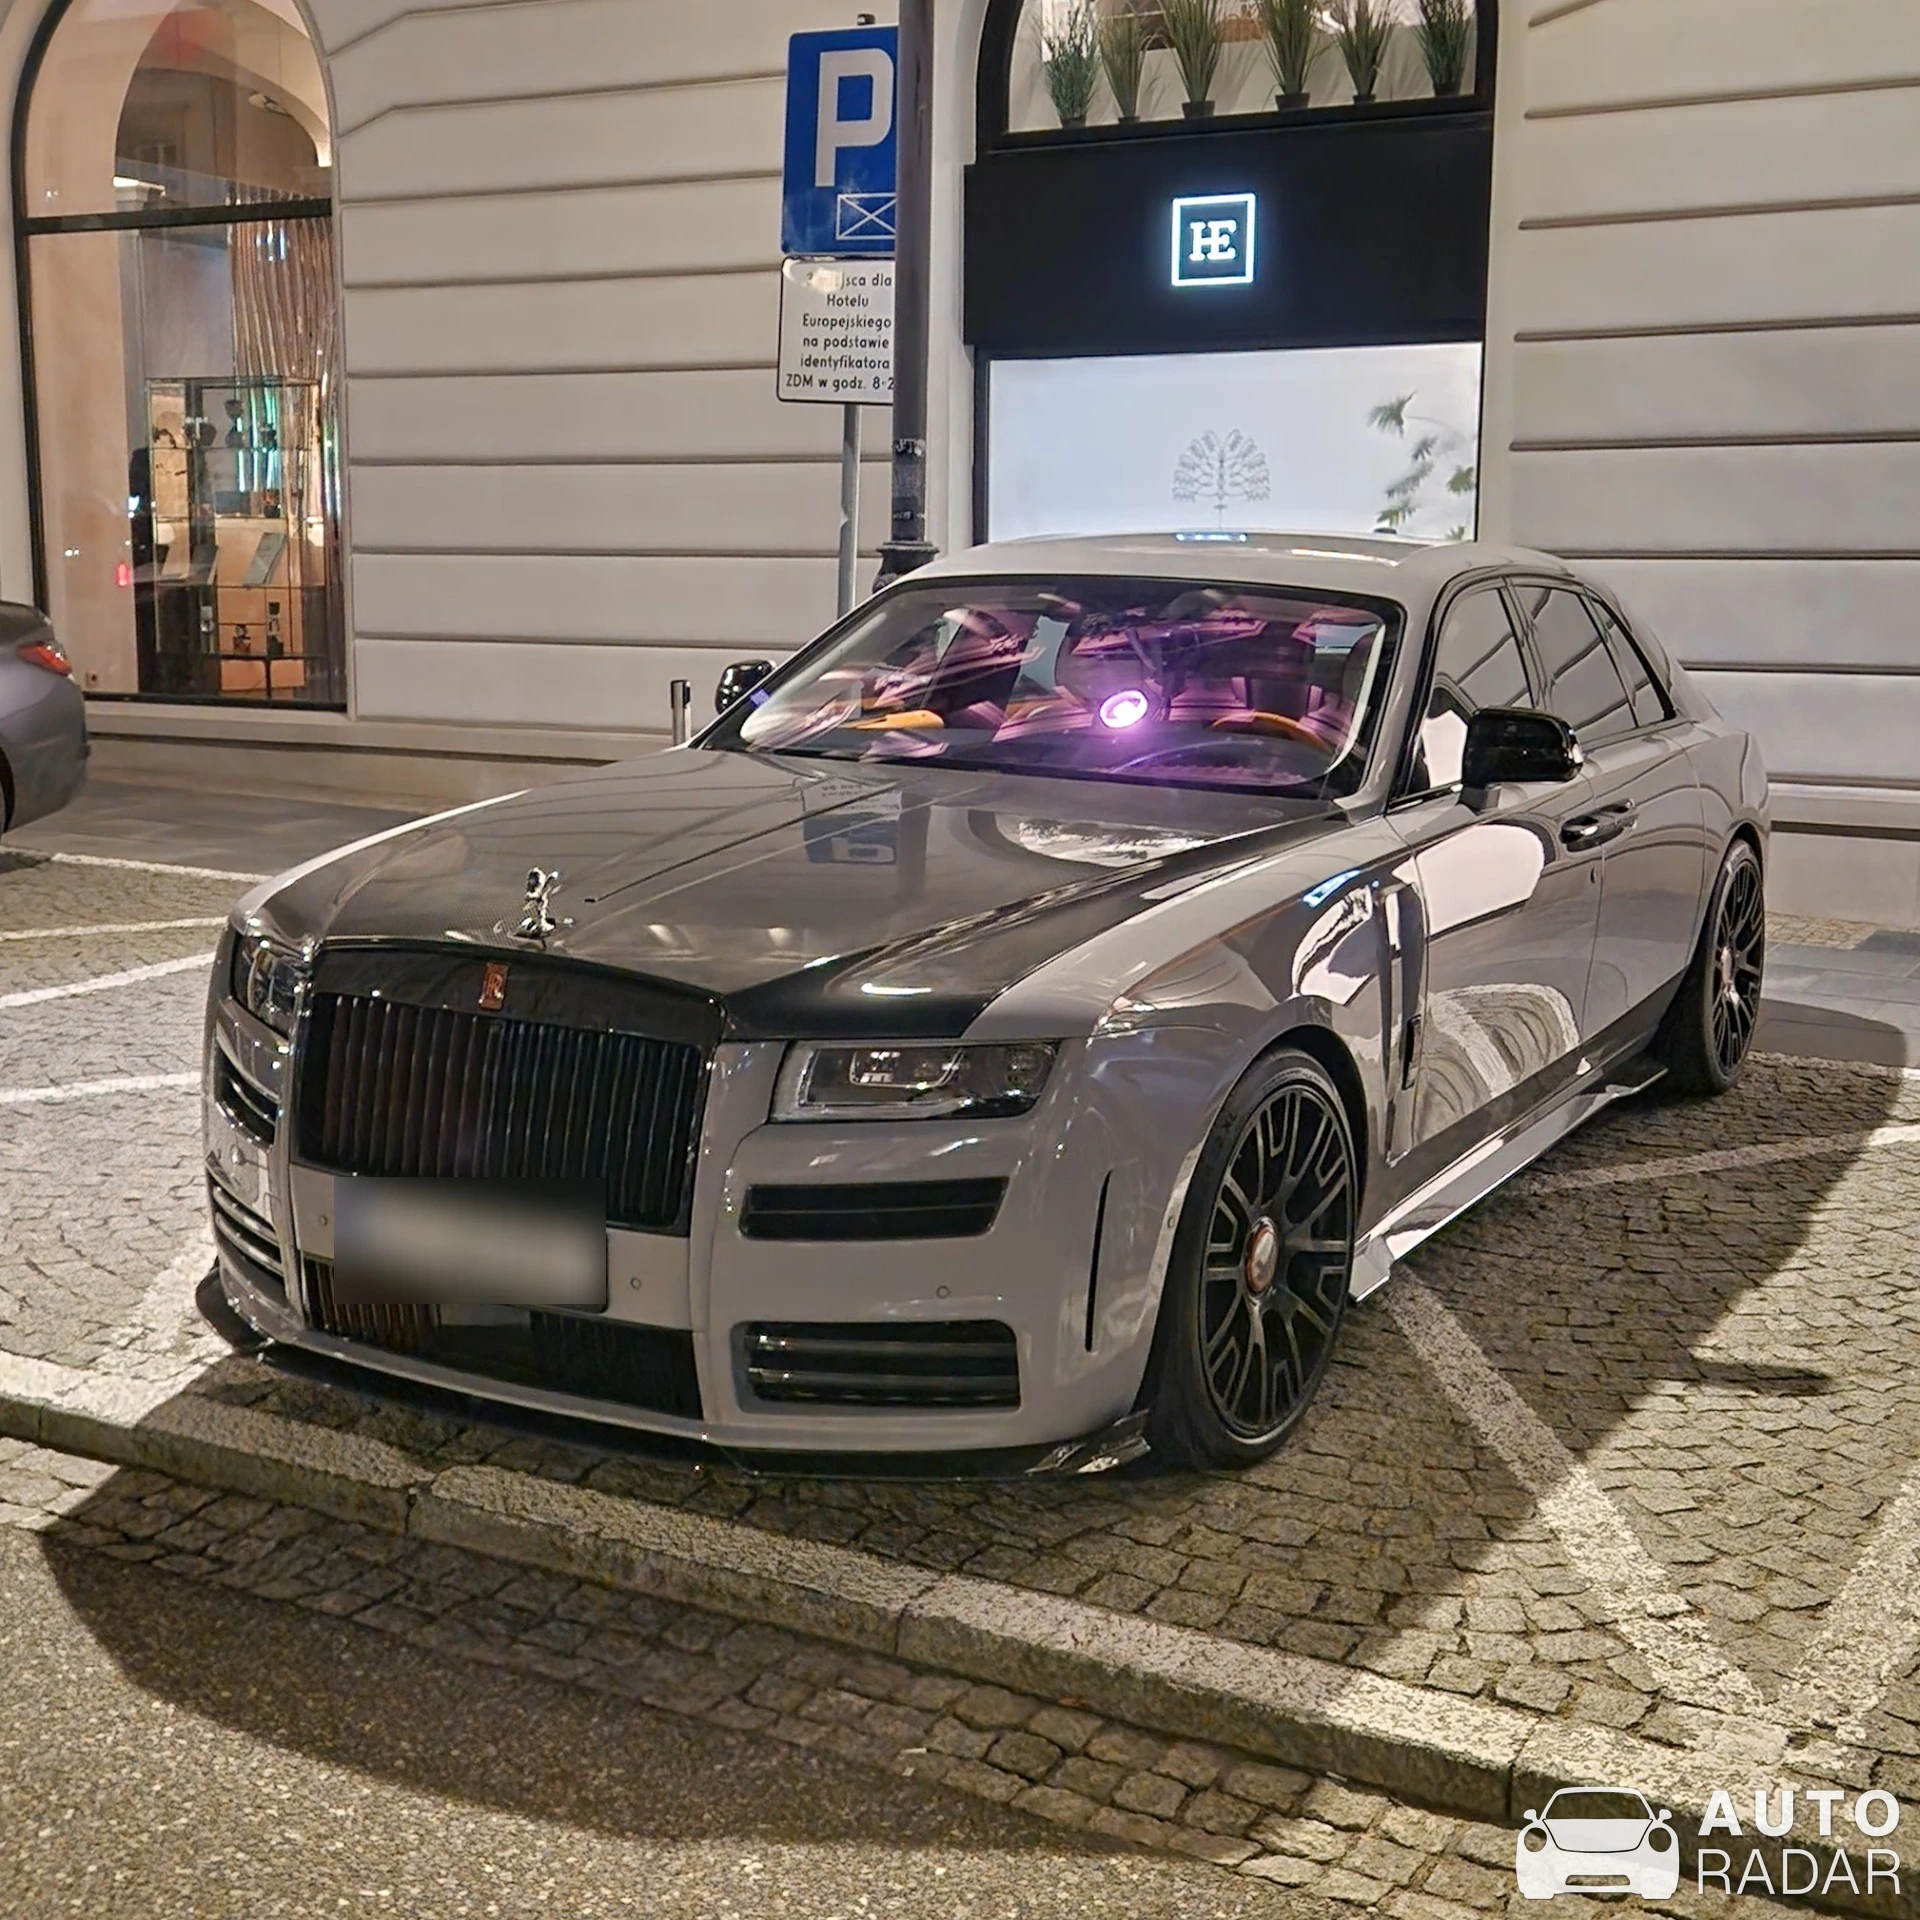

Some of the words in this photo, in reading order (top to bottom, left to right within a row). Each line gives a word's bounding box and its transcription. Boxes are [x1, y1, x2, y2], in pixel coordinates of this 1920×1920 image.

[815, 48, 894, 187] P
[871, 272, 892, 287] dla
[826, 294, 869, 307] Hotelu
[802, 313, 892, 331] Europejskiego
[803, 336, 818, 347] na
[823, 335, 889, 351] podstawie
[800, 354, 890, 372] identyfikatora
[786, 373, 813, 388] ZDM
[818, 379, 828, 388] w
[832, 376, 867, 392] godz.
